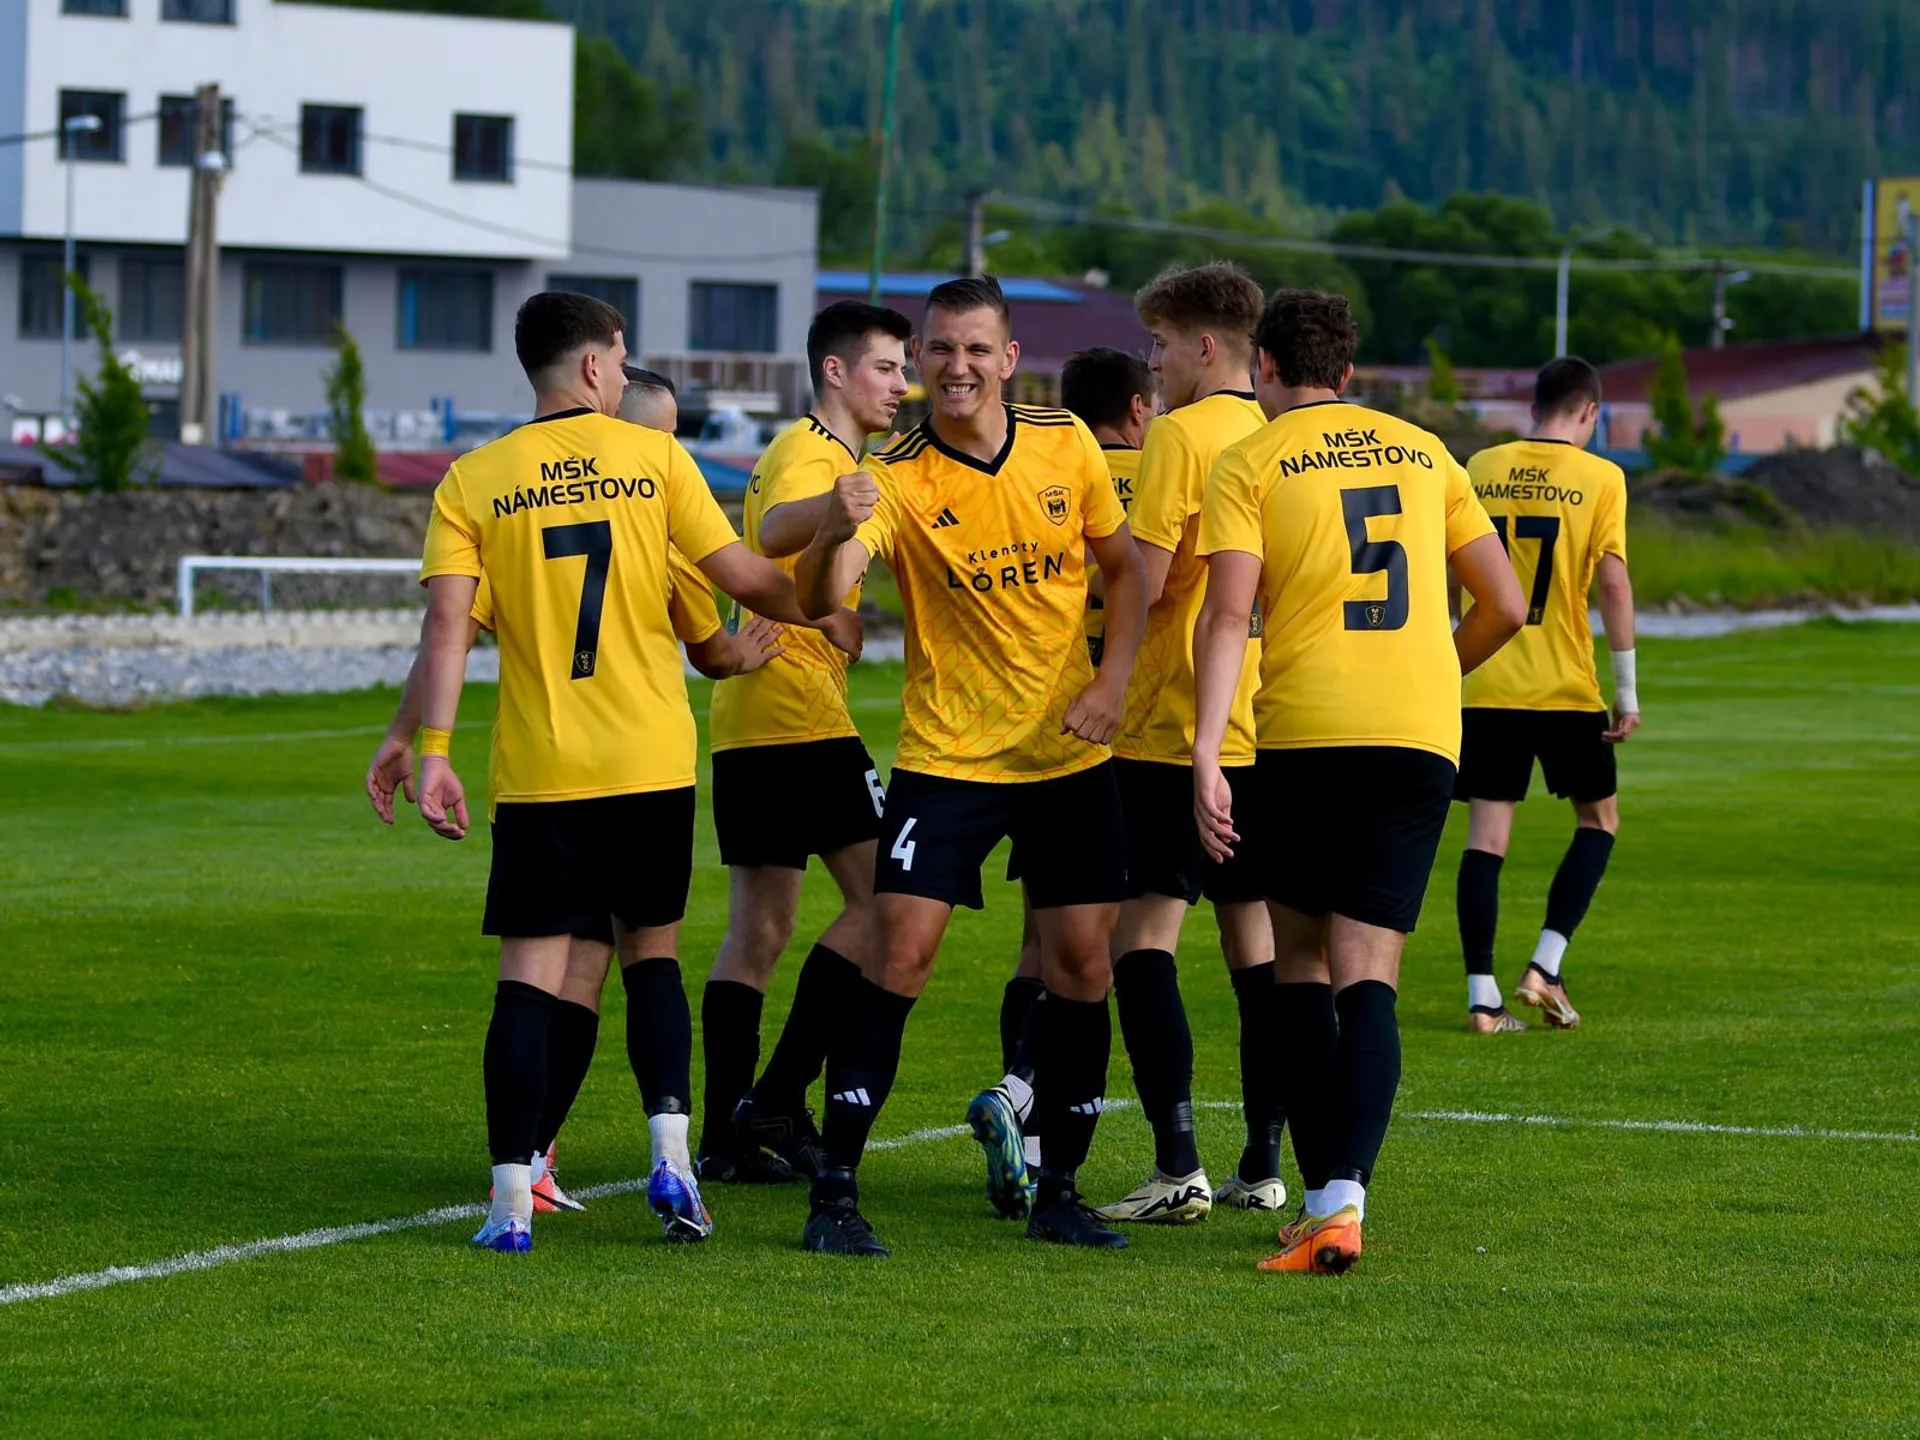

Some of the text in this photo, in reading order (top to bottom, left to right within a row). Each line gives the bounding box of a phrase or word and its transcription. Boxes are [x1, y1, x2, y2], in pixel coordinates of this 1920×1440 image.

[1322, 428, 1382, 449] MŠK
[540, 454, 600, 482] MŠK
[1279, 445, 1433, 478] NÁMESTOVO
[1508, 466, 1549, 483] MŠK
[492, 477, 656, 518] NÁMESTOVO
[1474, 480, 1583, 506] NÁMESTOVO
[968, 541, 1038, 564] Klenoty
[1339, 484, 1409, 631] 5
[541, 520, 613, 681] 7
[890, 817, 917, 871] 4
